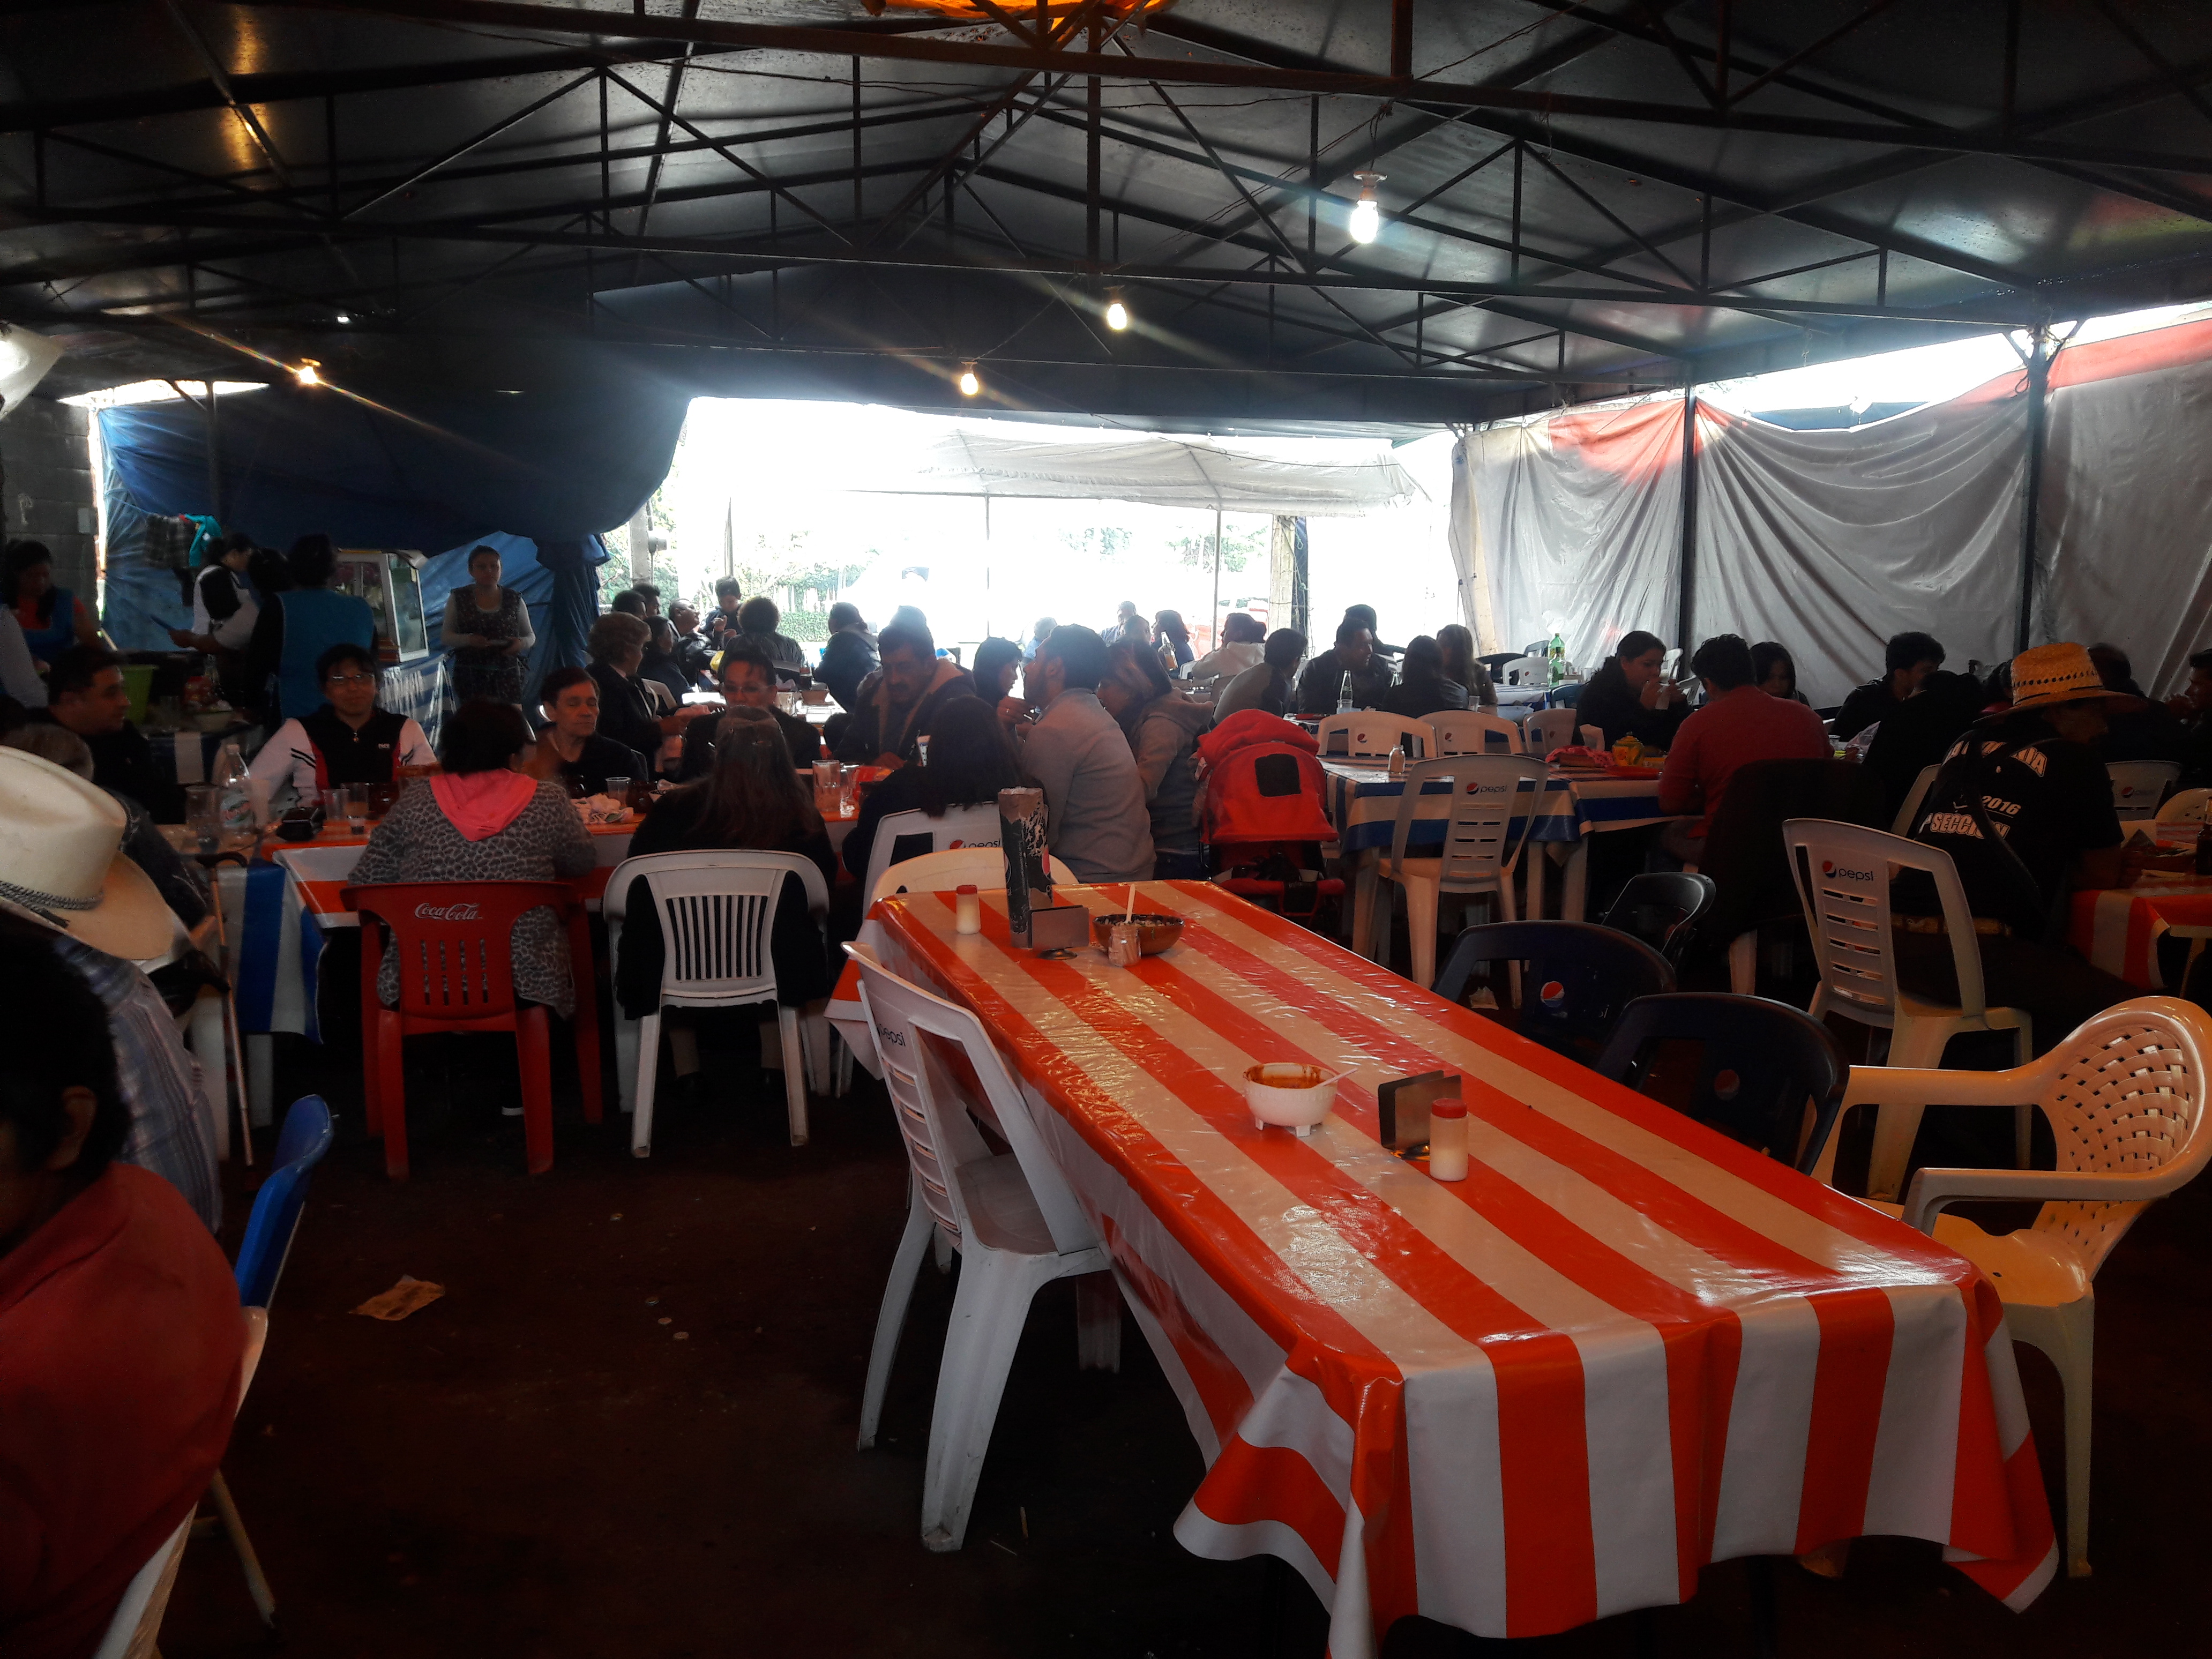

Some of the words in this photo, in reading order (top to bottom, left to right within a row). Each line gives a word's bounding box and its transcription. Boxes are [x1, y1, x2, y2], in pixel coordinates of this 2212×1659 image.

[1480, 785, 1507, 794] pepsi
[1982, 795, 2022, 815] 2016
[1839, 868, 1874, 881] pepsi
